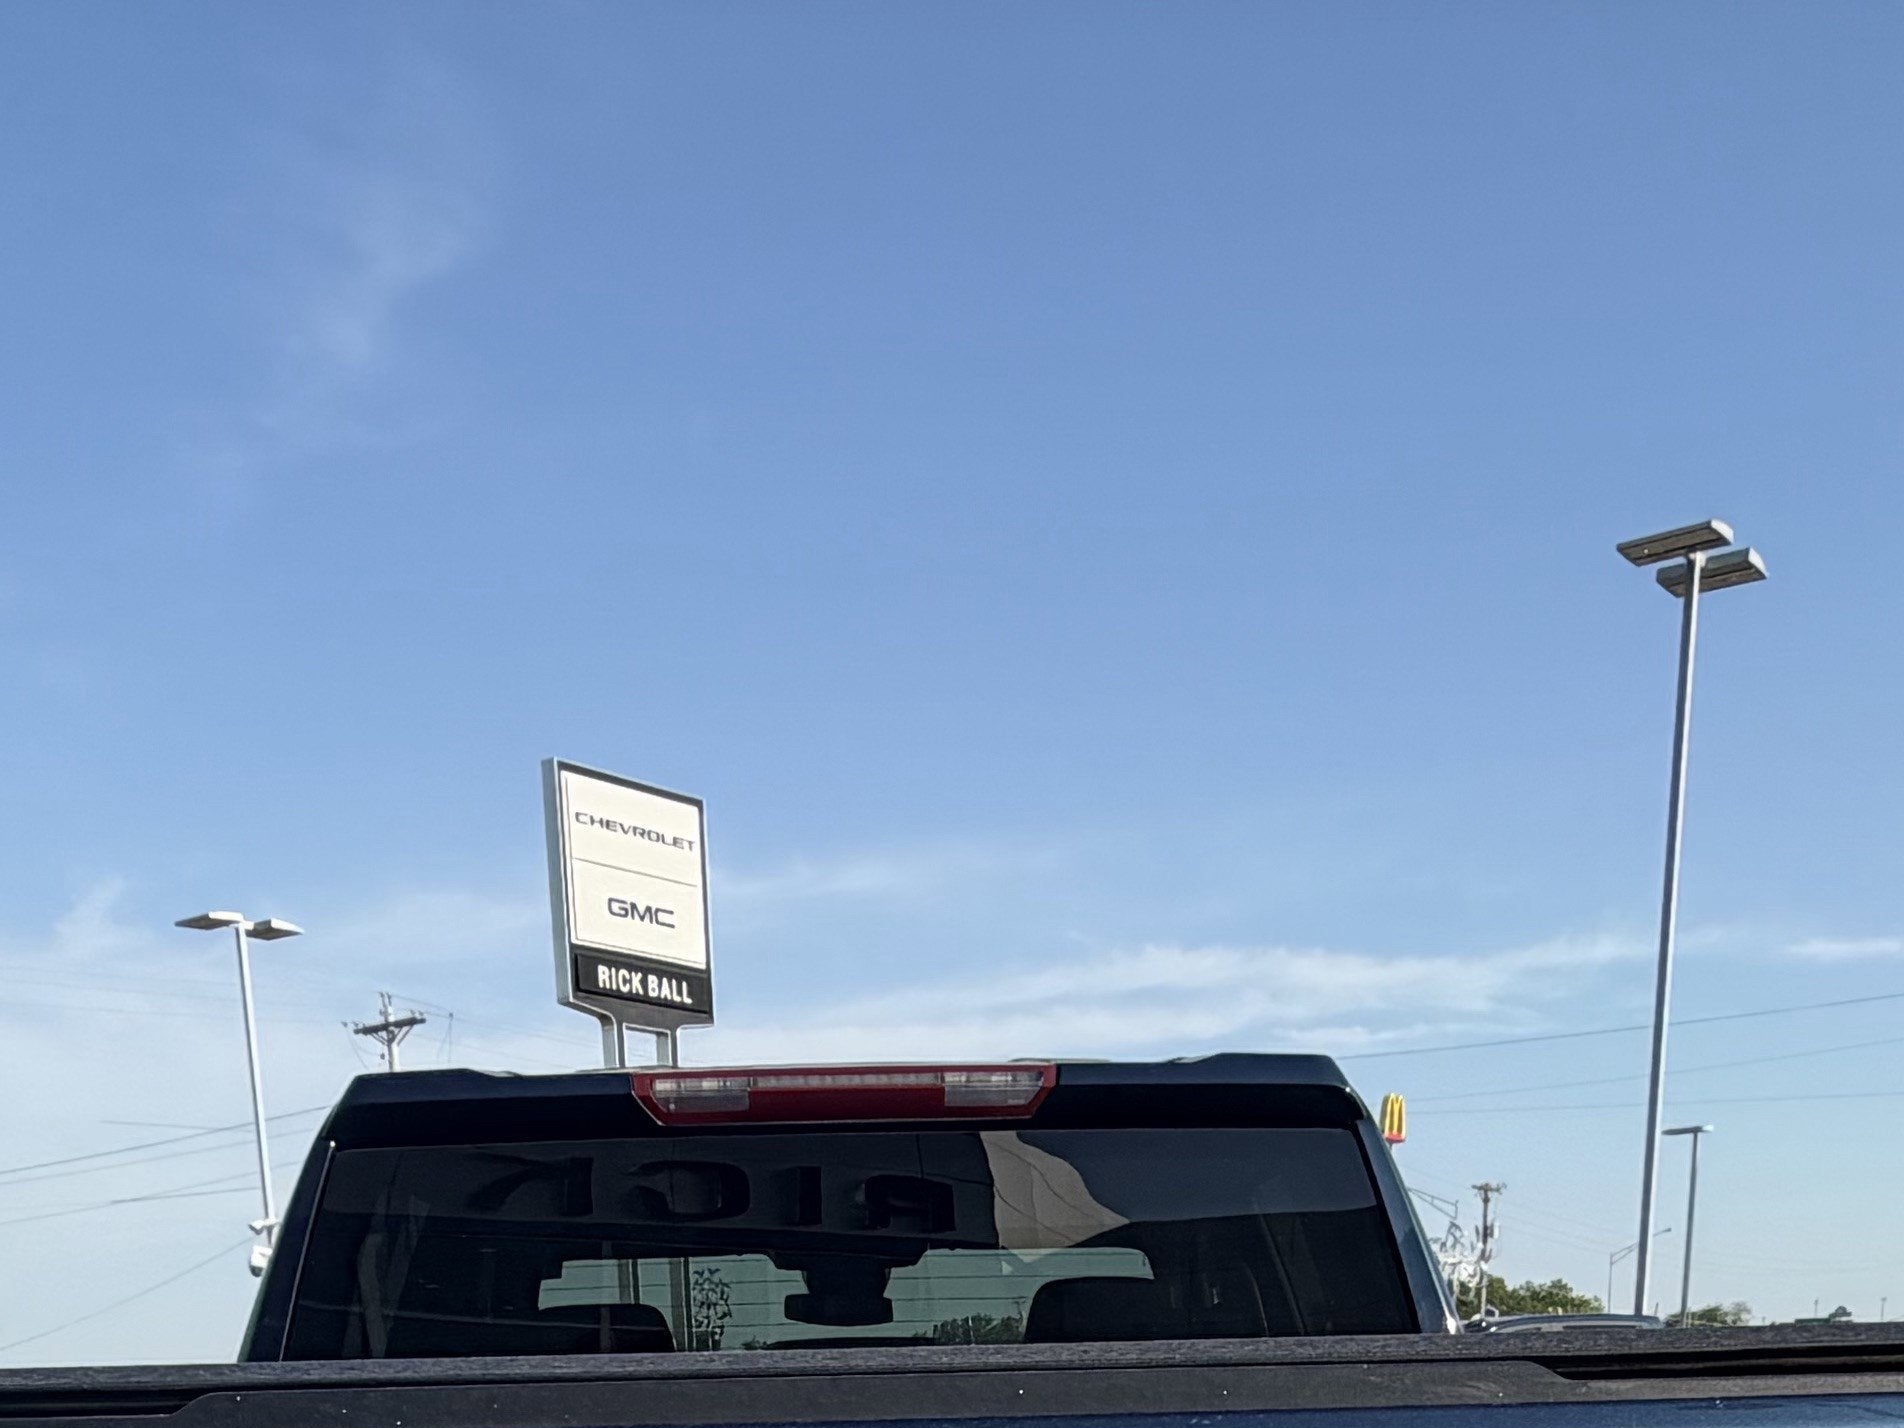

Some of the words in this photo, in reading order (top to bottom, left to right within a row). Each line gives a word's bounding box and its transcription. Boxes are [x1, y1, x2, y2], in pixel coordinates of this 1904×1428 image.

[574, 811, 696, 852] CHEVROLET
[607, 897, 676, 929] GMC
[597, 964, 645, 996] RICK
[647, 973, 693, 1004] BALL
